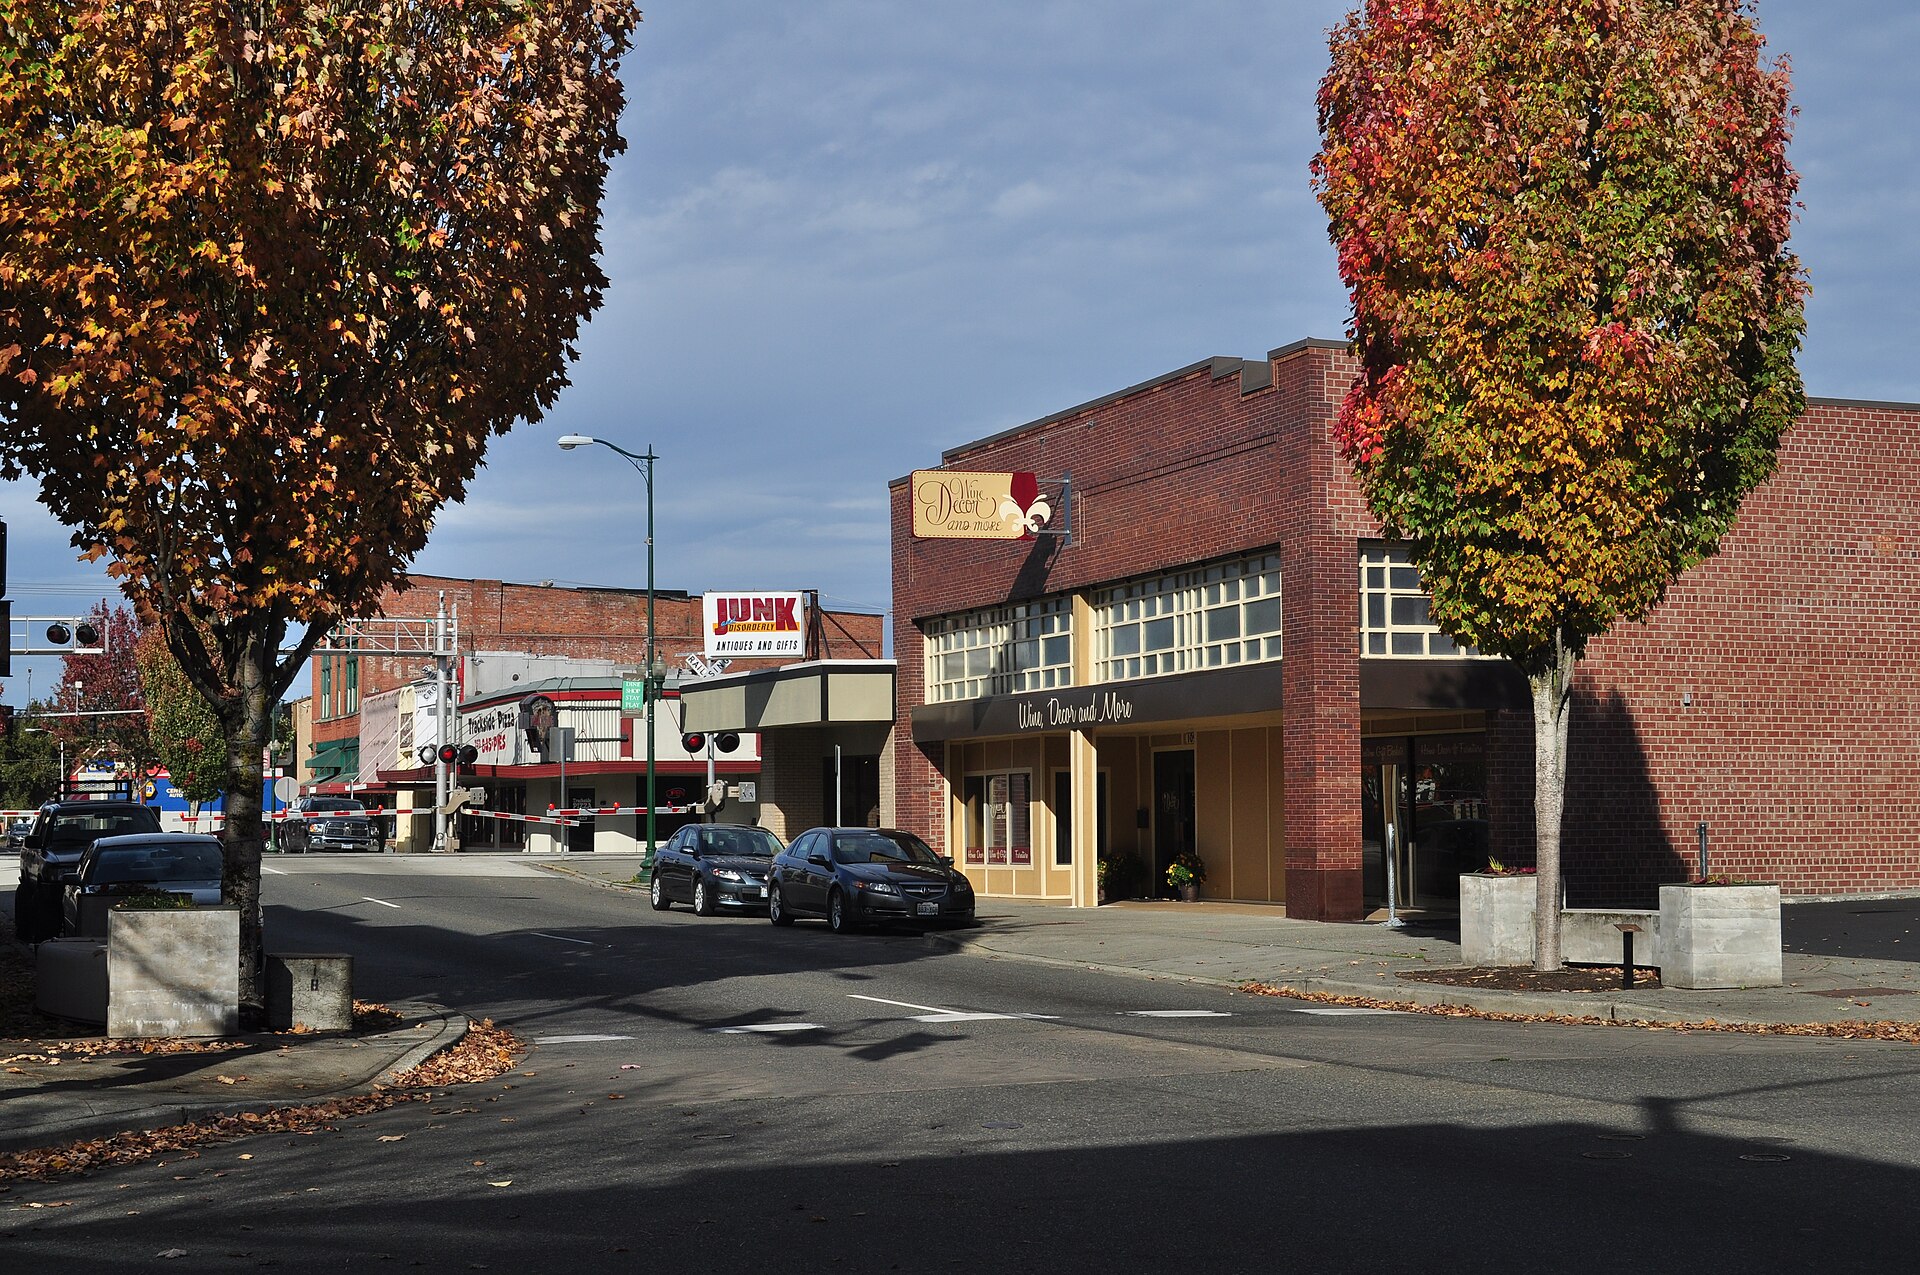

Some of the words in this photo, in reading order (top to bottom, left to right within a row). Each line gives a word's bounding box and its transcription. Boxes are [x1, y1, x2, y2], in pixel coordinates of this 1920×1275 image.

[715, 597, 798, 636] JUNK
[728, 622, 775, 632] DISORDERLY
[716, 640, 754, 651] ANTIQUES
[757, 640, 773, 651] AND
[776, 640, 798, 651] GIFTS
[687, 655, 708, 678] RAIL
[708, 659, 730, 678] SING
[1047, 697, 1076, 726] Decor
[1078, 692, 1097, 723] and
[1098, 691, 1133, 722] More
[468, 713, 495, 735] Trackside
[497, 711, 515, 729] Pizza
